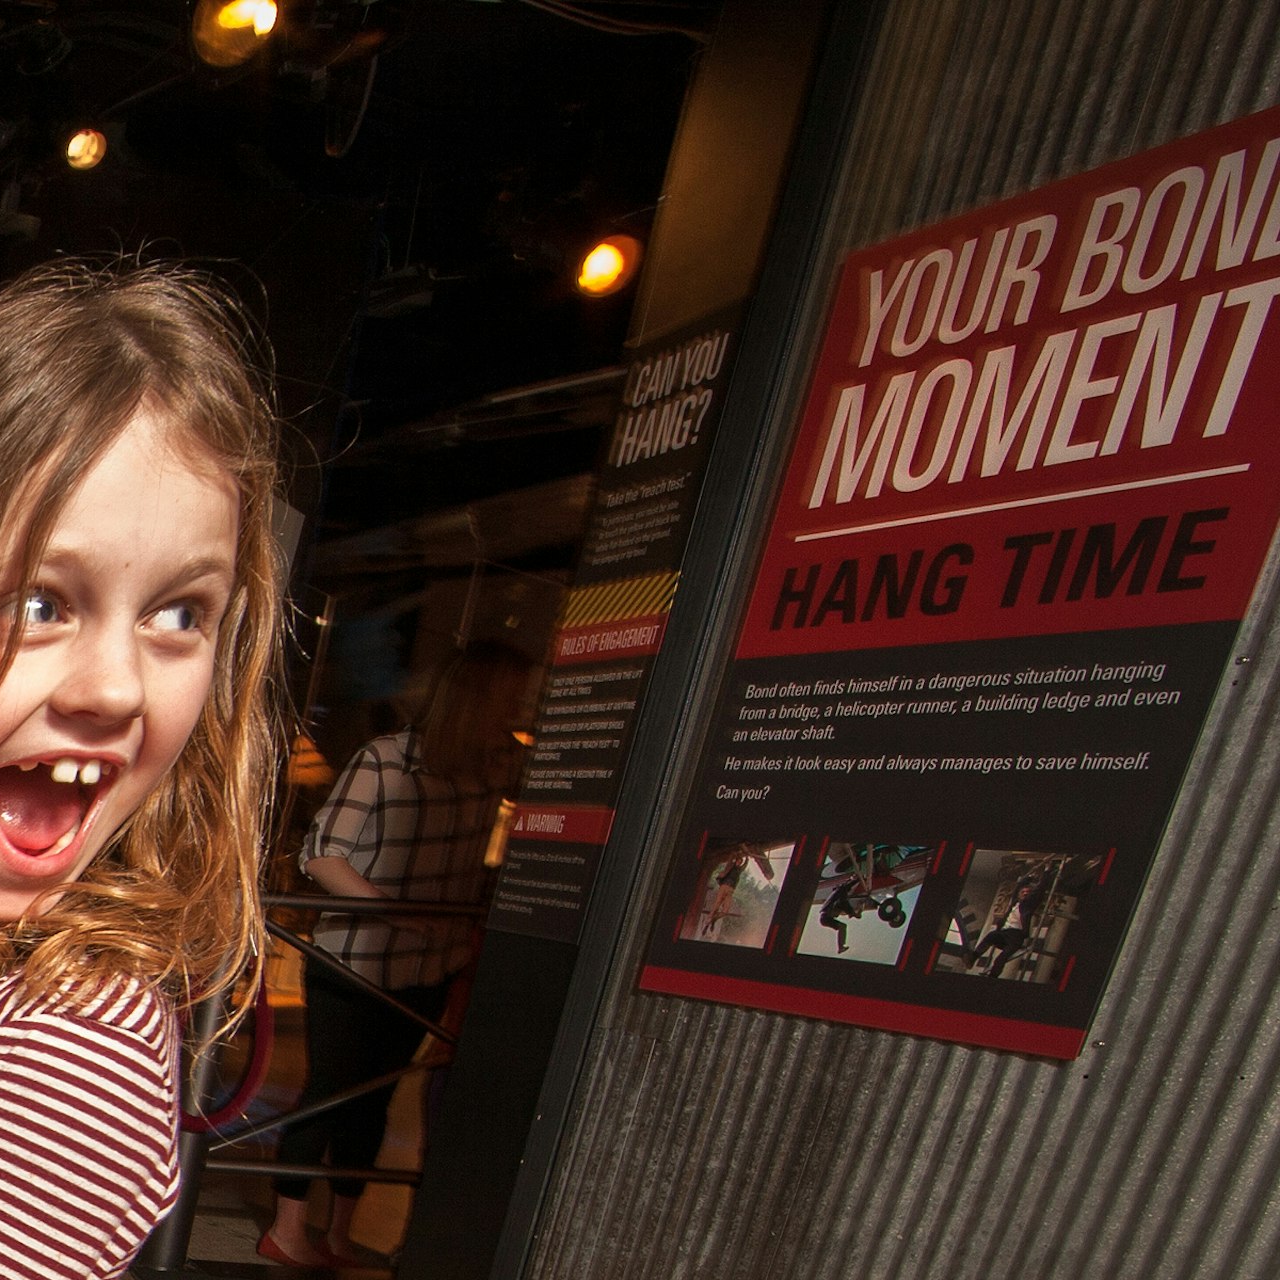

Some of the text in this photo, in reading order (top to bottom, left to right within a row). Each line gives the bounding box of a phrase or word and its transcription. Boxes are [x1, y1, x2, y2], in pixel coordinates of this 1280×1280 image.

[858, 138, 1280, 368] YOUR BON
[631, 332, 730, 408] CAN YOU
[808, 276, 1280, 510] MOMENT
[616, 388, 713, 468] HANG?
[770, 507, 1229, 631] HANG TIME
[560, 625, 660, 657] RULES OF ENGAGEMENT
[745, 660, 1167, 699] Bond often finds himself in a dangerous situation hanging
[739, 688, 1181, 722] from a bridge, a helicopter runner, a building ledge and even
[733, 724, 836, 742] an elevator shaft.
[724, 751, 1151, 774] He makes it look easy and always manages to save himself.
[716, 784, 771, 803] Can you?
[526, 814, 566, 834] WARNING
